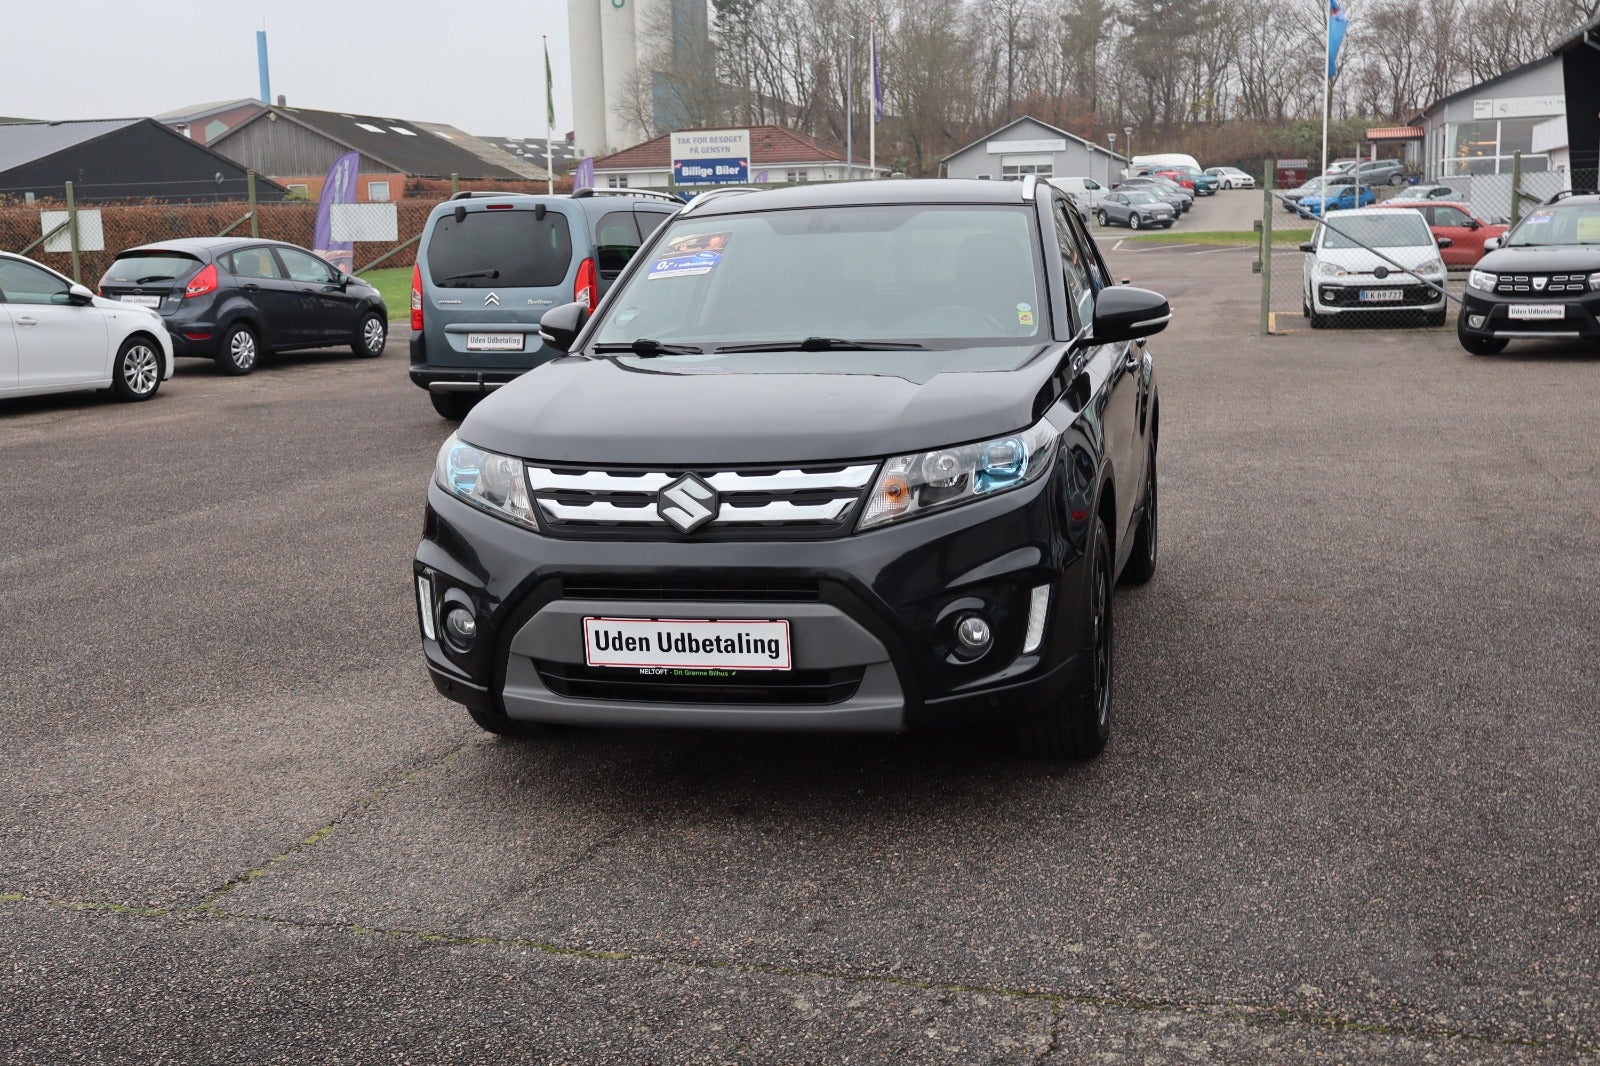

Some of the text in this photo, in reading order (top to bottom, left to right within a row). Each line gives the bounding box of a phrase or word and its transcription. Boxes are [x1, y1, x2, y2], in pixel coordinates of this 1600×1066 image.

[709, 135, 743, 143] BESØGET
[689, 146, 699, 154] PÅ
[681, 165, 740, 177] Billige Biler
[470, 336, 521, 345] Uden Udbetaling
[594, 630, 780, 659] Uden Udbetaling
